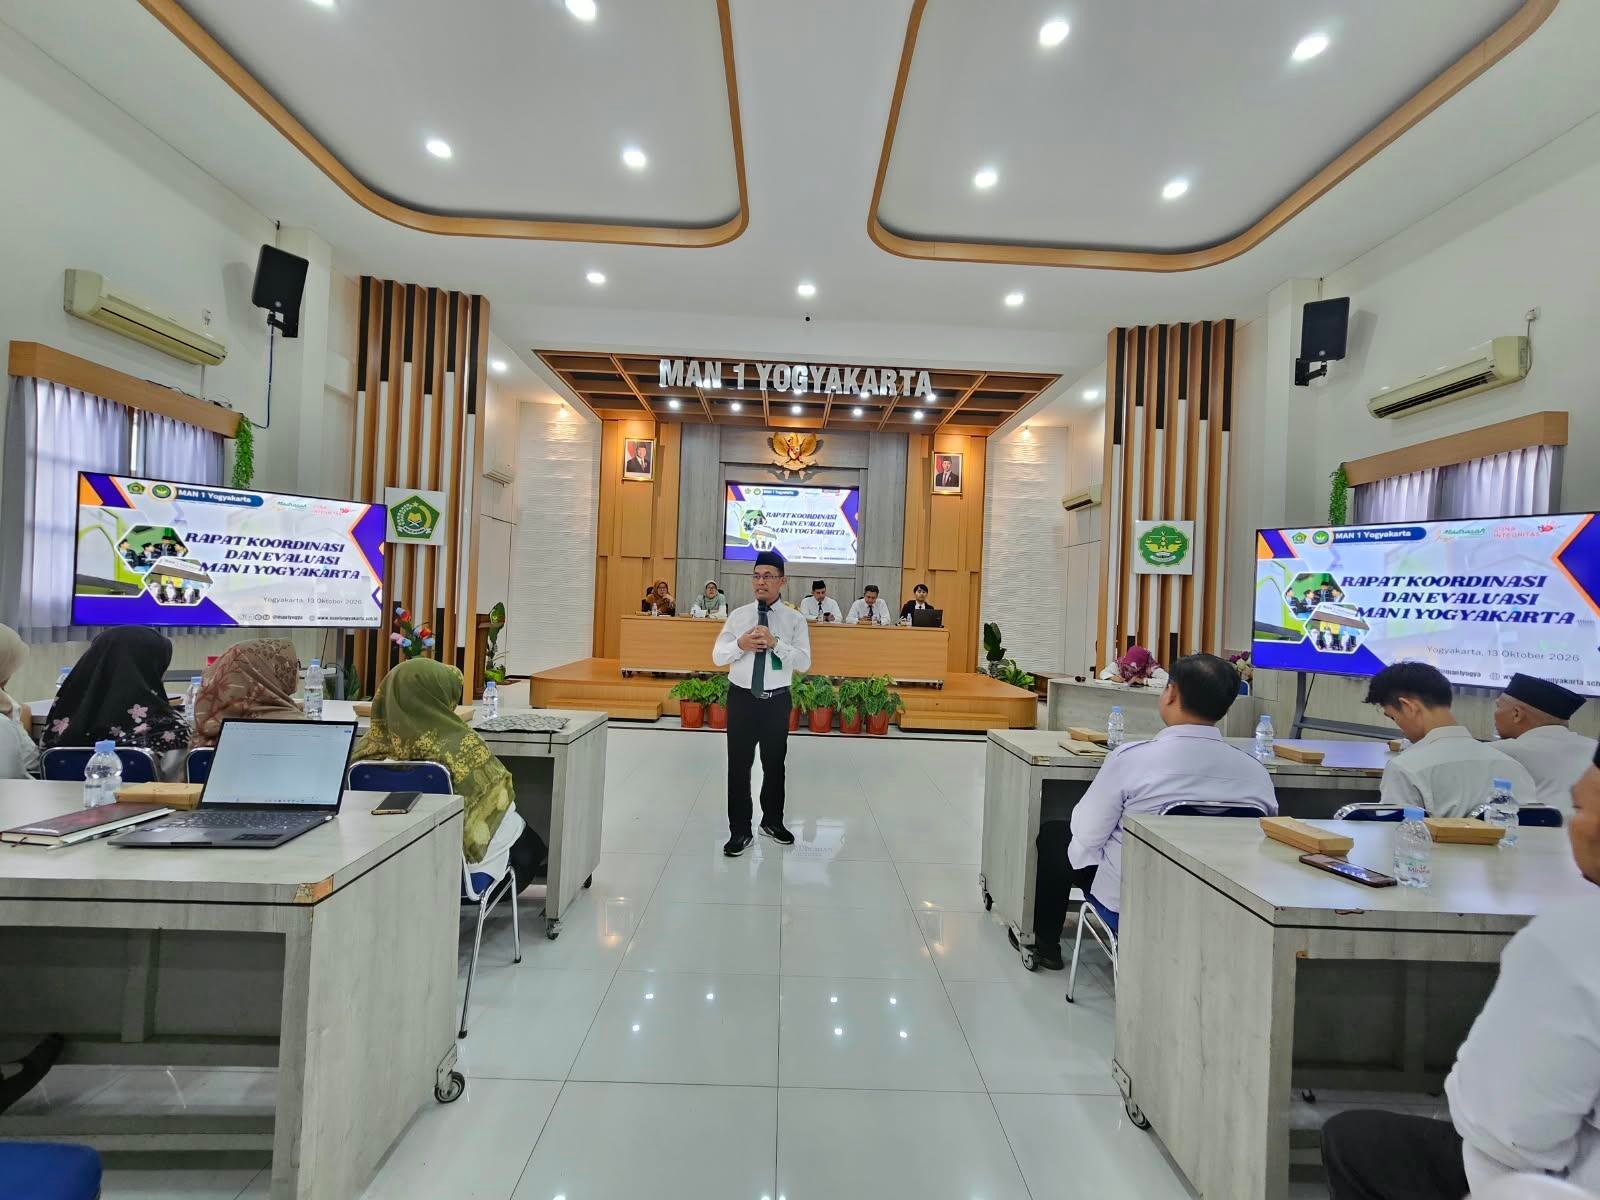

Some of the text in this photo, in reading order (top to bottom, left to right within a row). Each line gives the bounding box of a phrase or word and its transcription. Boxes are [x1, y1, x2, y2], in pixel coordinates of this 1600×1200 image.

[659, 359, 934, 398] MAN 1 YOGYAKARTA
[178, 489, 199, 498] MAN
[208, 492, 251, 504] Yogyakarta
[185, 532, 345, 553] RAPAT KOORDINASI
[1363, 530, 1412, 539] Yogyakarta
[224, 549, 341, 566] DAN EVALUASI
[199, 562, 241, 573] MAN
[253, 565, 361, 580] YOGYAKARTA
[1340, 575, 1549, 588] RAPAT KOORDINASI
[1381, 592, 1540, 606] DAN EVALUASI
[1355, 607, 1401, 618] MAN
[1415, 608, 1576, 625] YOGYAKARTA
[1487, 649, 1498, 657] 13
[1501, 650, 1545, 660] Oktober
[1548, 653, 1580, 662] 2026
